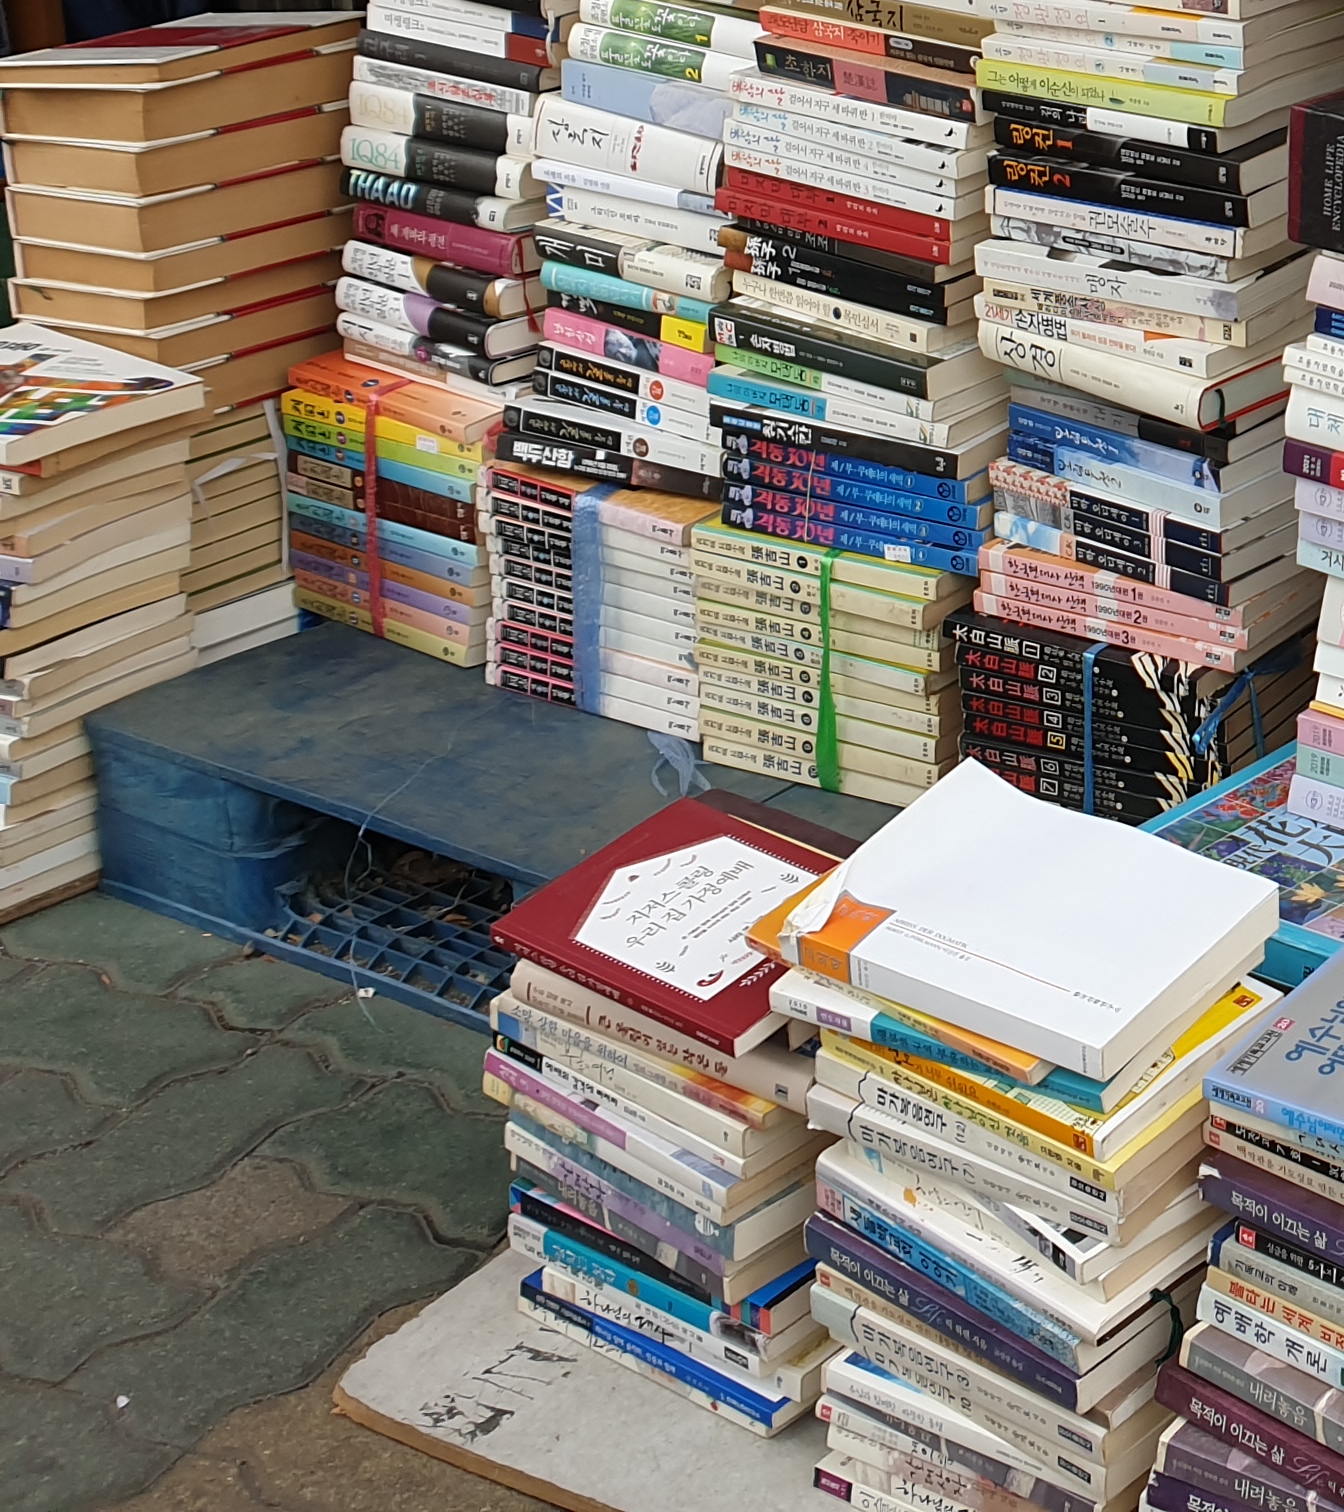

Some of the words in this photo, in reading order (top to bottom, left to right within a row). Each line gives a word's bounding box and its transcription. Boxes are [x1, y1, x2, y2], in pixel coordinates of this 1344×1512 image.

[350, 138, 400, 173] 1Q84
[1322, 143, 1335, 174] LIFE
[1322, 178, 1334, 217] HOME
